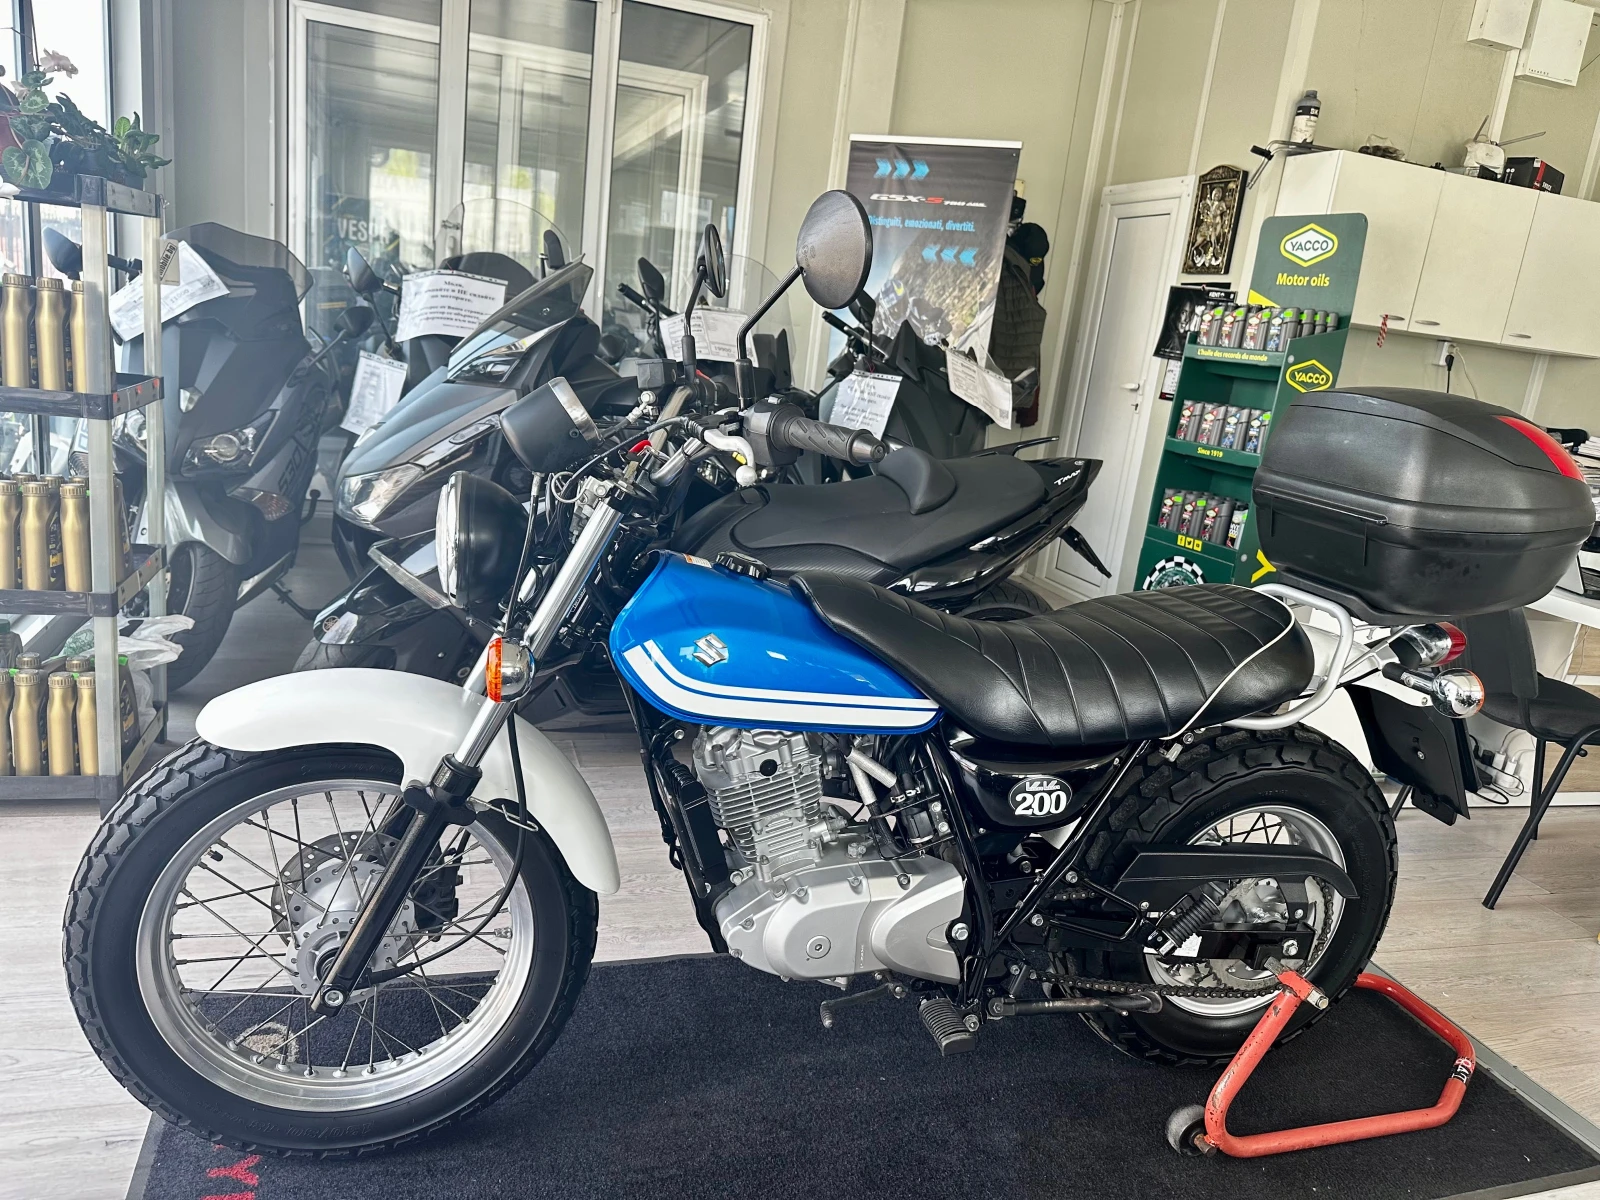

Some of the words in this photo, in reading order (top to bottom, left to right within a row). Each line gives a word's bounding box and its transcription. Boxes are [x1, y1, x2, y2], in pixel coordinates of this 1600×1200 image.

[869, 193, 944, 205] GSX-S
[904, 218, 944, 231] emozionati,
[945, 220, 975, 232] divertiti.
[1290, 240, 1329, 252] YACCO
[1276, 272, 1309, 286] Motor
[1310, 273, 1330, 287] oils
[1294, 371, 1327, 384] YACCO
[1197, 447, 1210, 456] Since
[1015, 790, 1067, 815] 200
